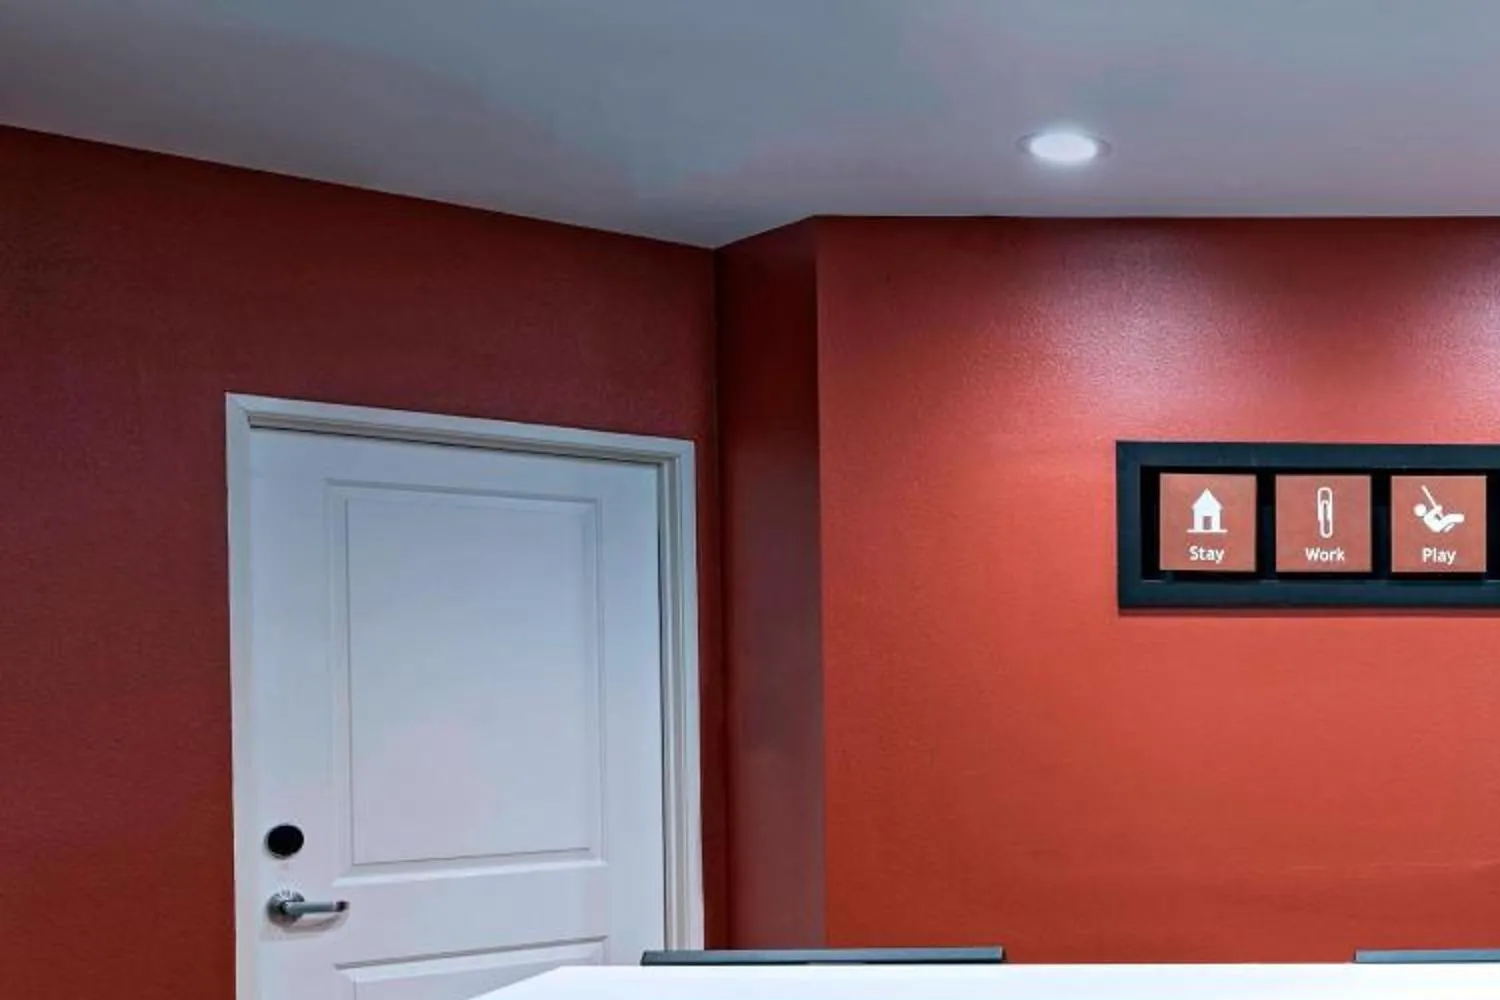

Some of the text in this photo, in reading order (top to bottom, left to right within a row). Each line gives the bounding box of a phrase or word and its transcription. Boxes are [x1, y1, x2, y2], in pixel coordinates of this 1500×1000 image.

[1189, 545, 1225, 564] Stay
[1305, 547, 1345, 562] Work
[1422, 547, 1457, 565] Play
